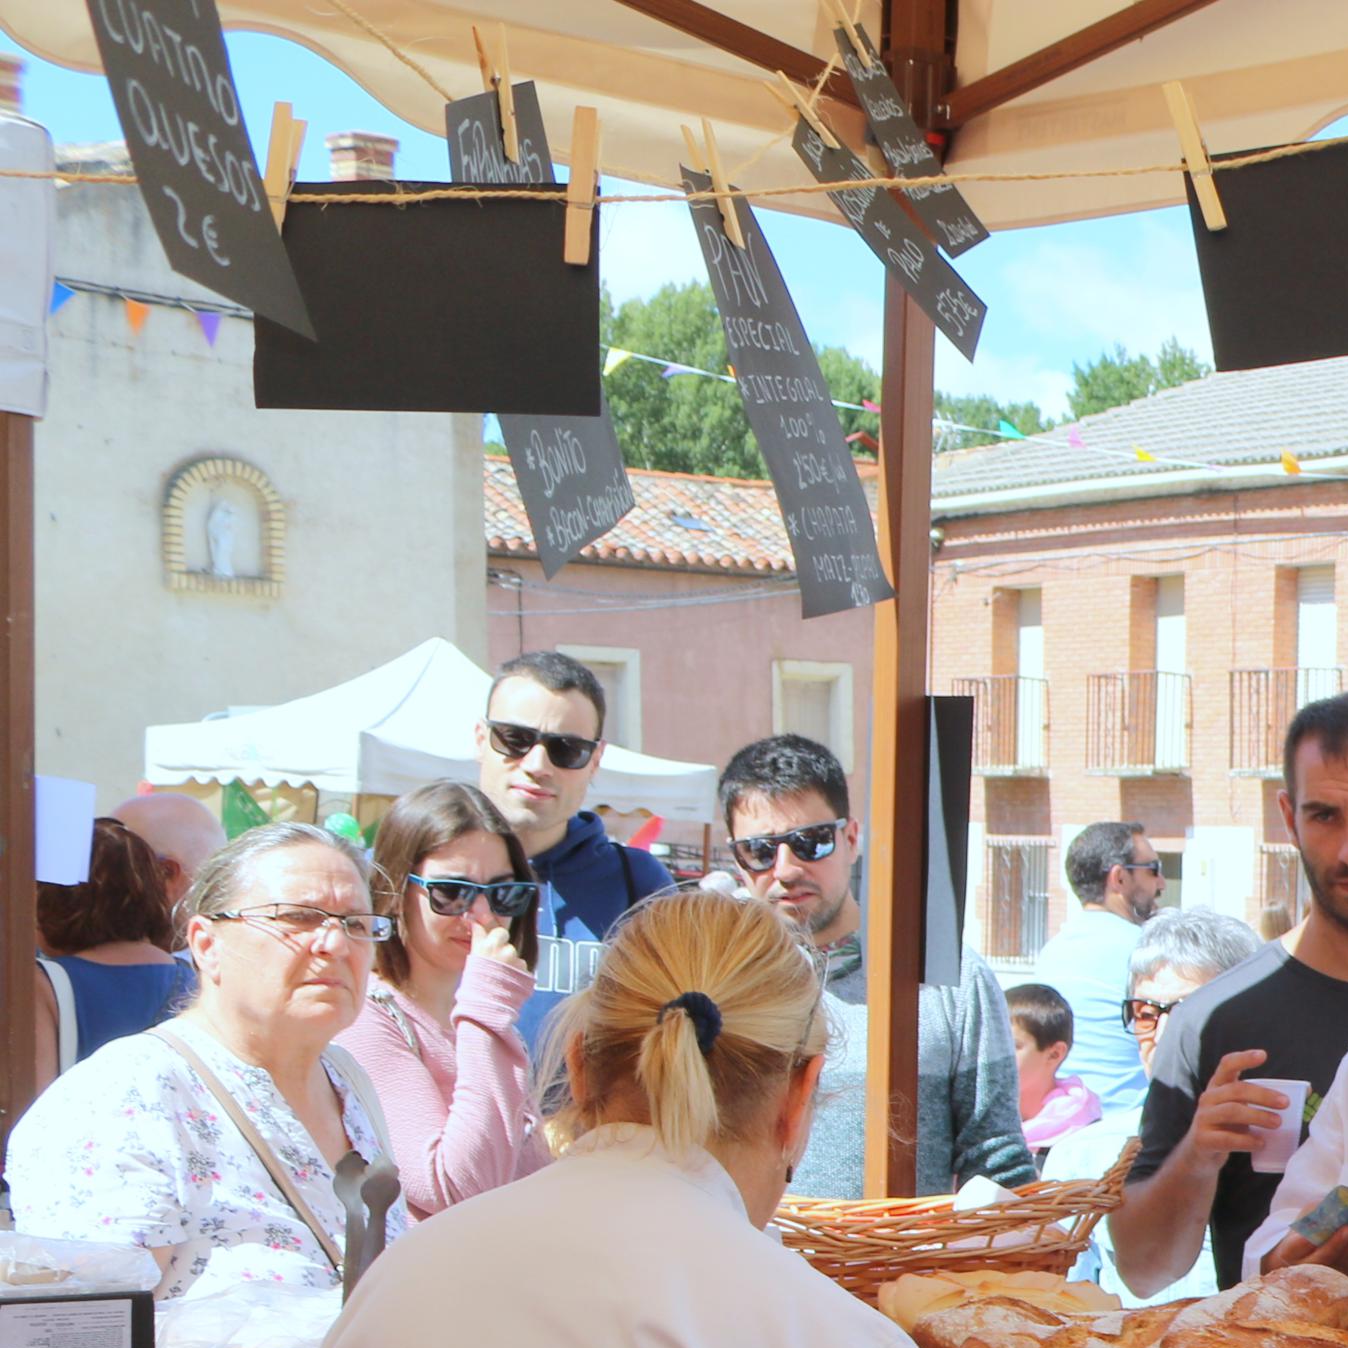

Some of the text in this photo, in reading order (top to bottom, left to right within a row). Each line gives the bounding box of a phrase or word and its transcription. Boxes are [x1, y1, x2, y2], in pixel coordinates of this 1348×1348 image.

[126, 78, 261, 213] QUESOS
[704, 224, 769, 308] PAN
[887, 237, 925, 285] PALO
[725, 316, 800, 356] ESPECIAL
[800, 505, 858, 541] CHAPATA
